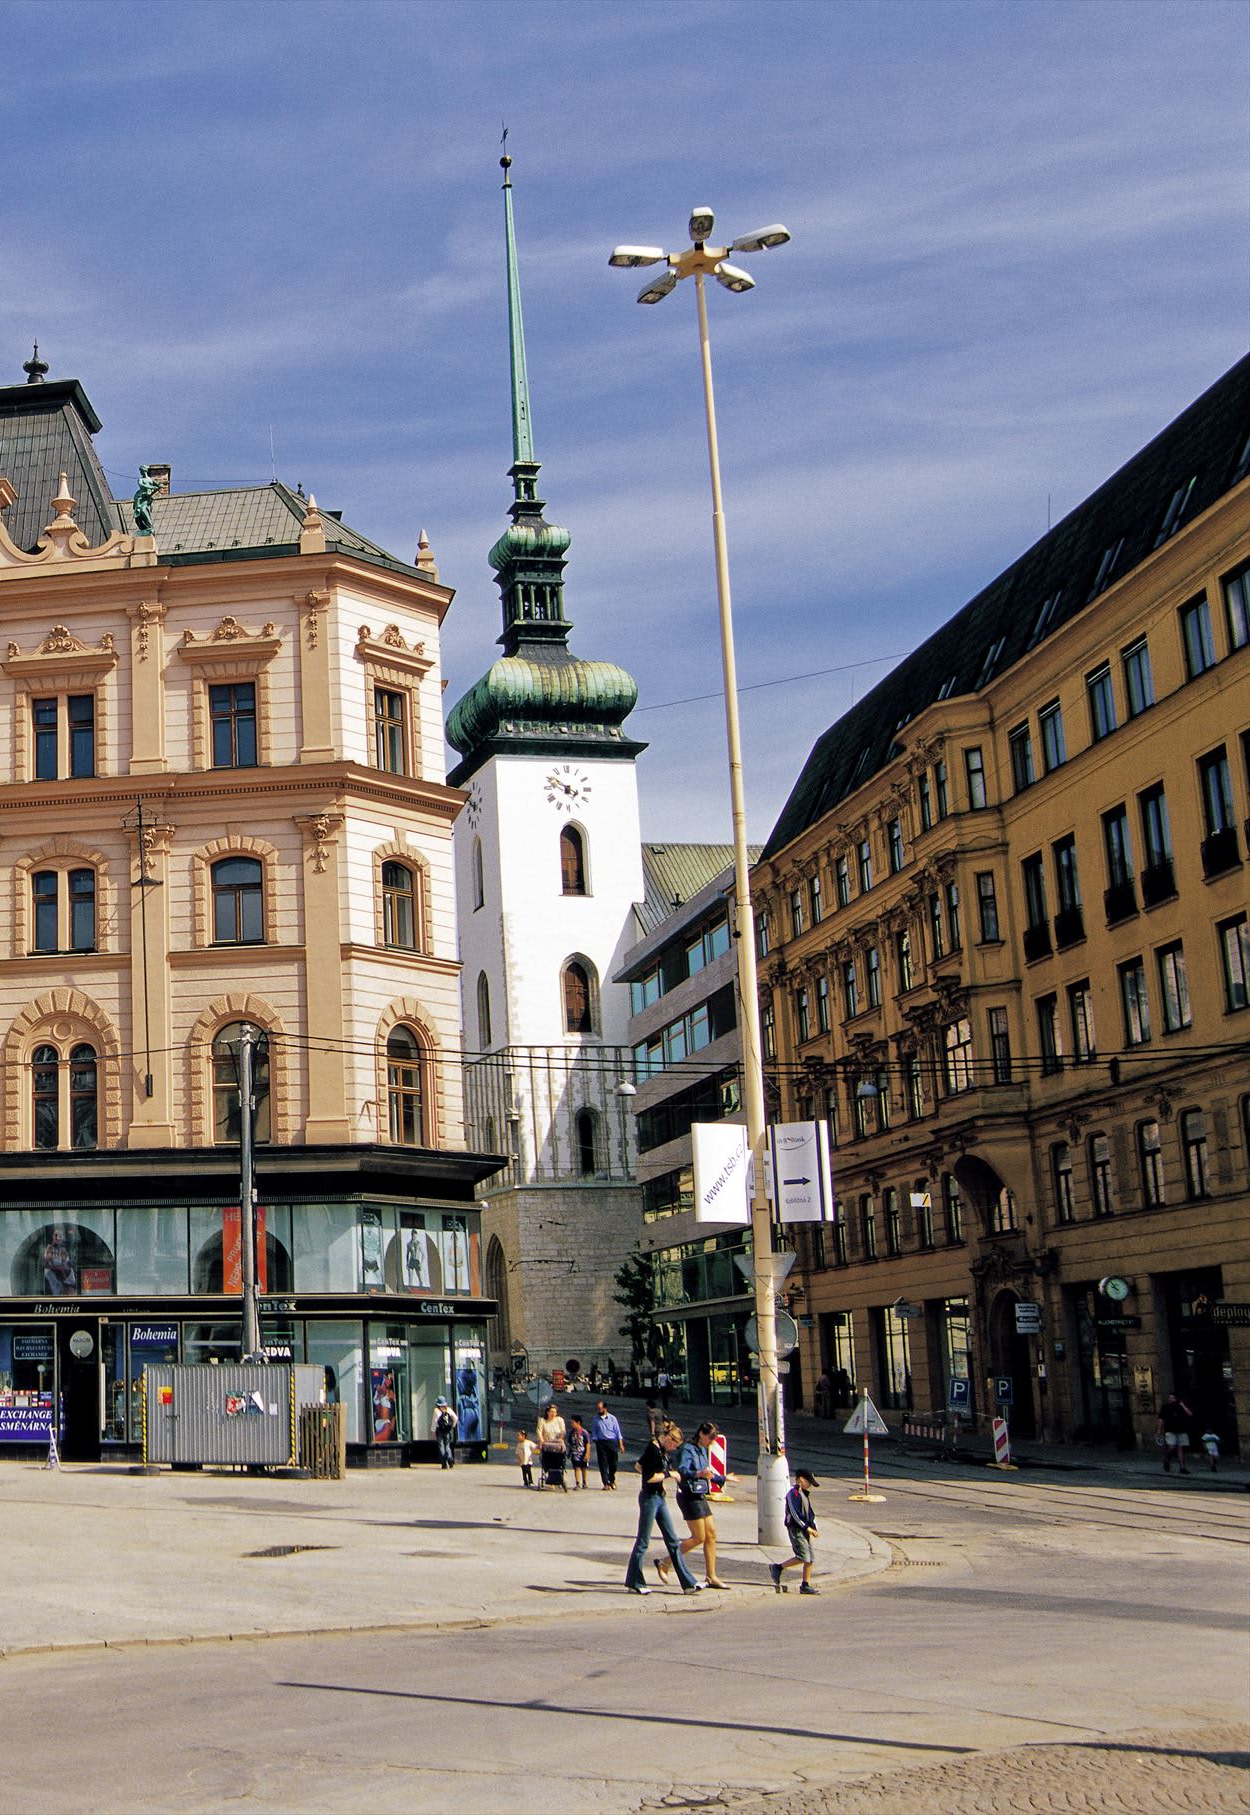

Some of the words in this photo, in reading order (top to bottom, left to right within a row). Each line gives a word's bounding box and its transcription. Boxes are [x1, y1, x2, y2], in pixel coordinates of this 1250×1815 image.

[34, 1303, 81, 1314] Bohemia
[420, 1301, 455, 1314] CenTex
[132, 1327, 177, 1341] Bohemia
[954, 1382, 966, 1399] P
[998, 1381, 1009, 1396] P
[0, 1410, 53, 1420] EXCHANGE
